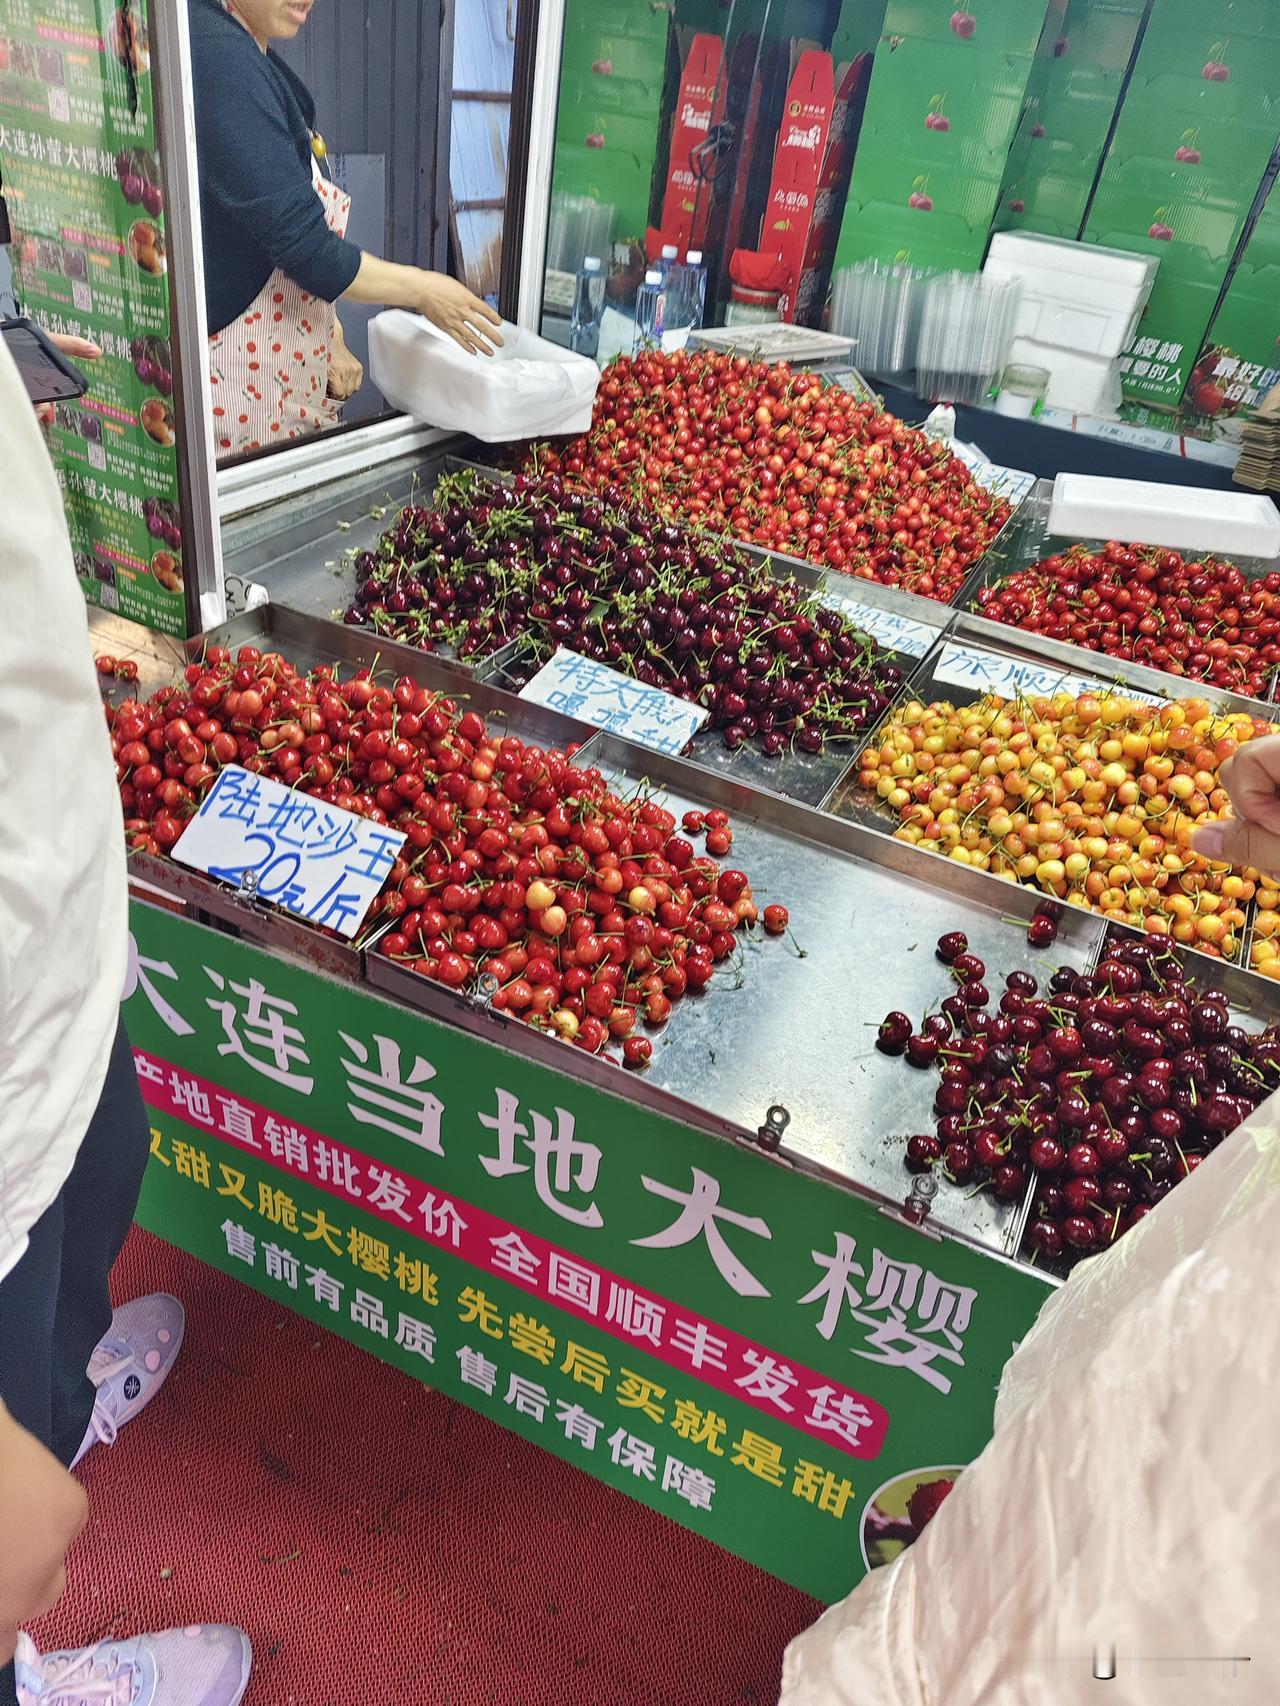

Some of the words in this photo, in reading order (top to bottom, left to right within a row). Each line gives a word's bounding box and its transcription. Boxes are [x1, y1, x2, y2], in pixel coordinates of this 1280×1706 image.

[1130, 335, 1184, 364] 樱桃
[1222, 382, 1264, 407] 给最
[200, 770, 404, 883] 陆地沙王
[122, 930, 1020, 1394] 大连当地大樱
[133, 1054, 469, 1249] 产地直销批发价
[489, 1231, 874, 1449] 全国顺丰发货
[148, 1127, 439, 1308] 又甜又脆大樱桃
[458, 1286, 855, 1520] 先尝后买就是甜
[220, 1218, 437, 1366] 售前有品质
[455, 1345, 717, 1513] 售后有保障
